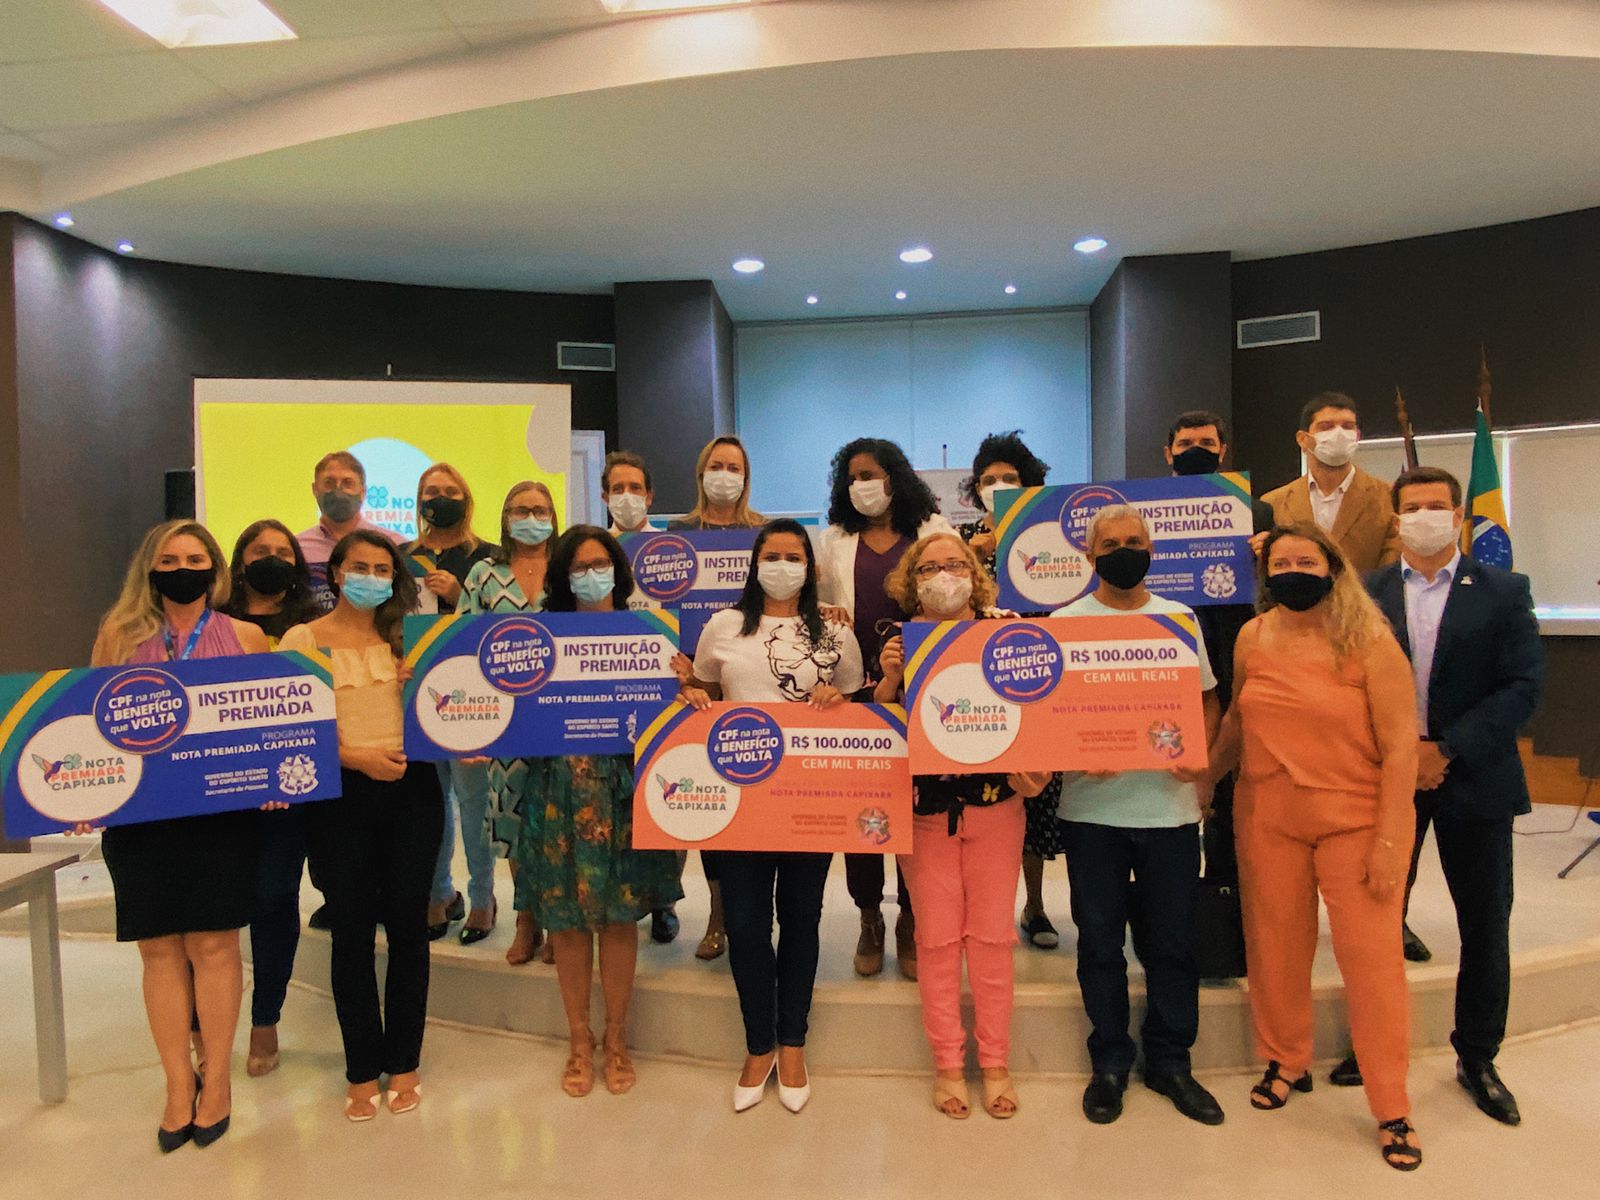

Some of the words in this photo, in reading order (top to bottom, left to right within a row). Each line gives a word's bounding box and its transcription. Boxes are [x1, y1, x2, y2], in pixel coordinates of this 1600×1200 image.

[391, 497, 415, 509] NO
[365, 511, 413, 522] REMIA
[1070, 506, 1089, 518] CPF
[1154, 518, 1233, 533] PREMIADA
[1188, 541, 1235, 550] PROGRAMA
[643, 554, 660, 565] CPF
[1053, 556, 1081, 564] NOTA
[1190, 549, 1235, 559] CAPIXABA
[645, 559, 694, 574] BENEFÍCIO
[704, 556, 752, 569] INSTITU
[1029, 563, 1081, 572] PREMIADA
[656, 570, 688, 582] VOLTA
[1030, 571, 1082, 580] CAPIXABA
[681, 602, 703, 610] NOTA
[490, 640, 511, 653] CPF
[512, 641, 523, 649] na
[523, 638, 542, 647] nota
[564, 639, 661, 658] INSTITUIÇÃO
[993, 646, 1014, 659] CPF
[1016, 646, 1027, 654] na
[1028, 643, 1047, 653] nota
[493, 646, 551, 664] BENEFÍCIO
[989, 662, 995, 671] é
[997, 651, 1057, 671] BENEFÍCIO
[1070, 650, 1090, 664] R$
[1094, 647, 1178, 662] 100.000,00
[489, 666, 506, 677] que
[507, 659, 545, 674] VOLTA
[580, 658, 661, 673] PREMIADA
[994, 674, 1011, 684] que
[1012, 665, 1052, 681] VOLTA
[1083, 672, 1111, 684] CEM
[1115, 671, 1138, 683] MIL
[1142, 670, 1179, 681] REAIS
[198, 681, 312, 707] INSTITUIÇÃO
[615, 684, 662, 693] PROGRAMA
[108, 694, 133, 709] CPF
[135, 694, 148, 703] na
[149, 689, 171, 700] nota
[468, 696, 500, 704] NOTA
[538, 695, 563, 705] NOTA
[565, 694, 613, 703] PREMIADA
[615, 692, 662, 702] CAPIXABA
[104, 712, 111, 722] é
[113, 697, 183, 722] BENEFÍCIO
[218, 700, 314, 723] PREMIADA
[440, 704, 500, 713] PREMIADA
[973, 705, 1007, 714] NOTA
[1052, 705, 1078, 714] NOTA
[1081, 704, 1131, 713] PREMIADA
[110, 723, 129, 735] que
[131, 711, 177, 730] VOLTA
[441, 712, 500, 722] CAPIXABA
[945, 714, 1007, 724] PREMIADA
[261, 728, 316, 741] PROGRAMA
[718, 729, 739, 741] CPF
[752, 728, 770, 737] nota
[946, 723, 1008, 733] CAPIXABA
[172, 749, 201, 761] NOTA
[204, 743, 261, 758] PREMIADA
[263, 737, 316, 751] CAPIXABA
[714, 743, 720, 753] é
[721, 736, 779, 753] BENEFÍCIO
[791, 736, 809, 749] R$
[814, 737, 892, 751] 100.000,00
[85, 757, 125, 769] NOTA
[717, 756, 733, 765] que
[735, 750, 772, 763] VOLTA
[802, 758, 828, 769] CEM
[831, 759, 853, 769] MIL
[857, 759, 892, 770] REAIS
[50, 766, 126, 782] PREMIADA
[52, 775, 126, 791] CAPIXABA
[695, 785, 726, 794] NOTA
[669, 794, 726, 802] PREMIADA
[770, 789, 794, 797] NOTA
[797, 790, 844, 798] PREMIADA
[846, 790, 892, 798] CAPIXABA
[668, 802, 726, 812] CAPIXABA
